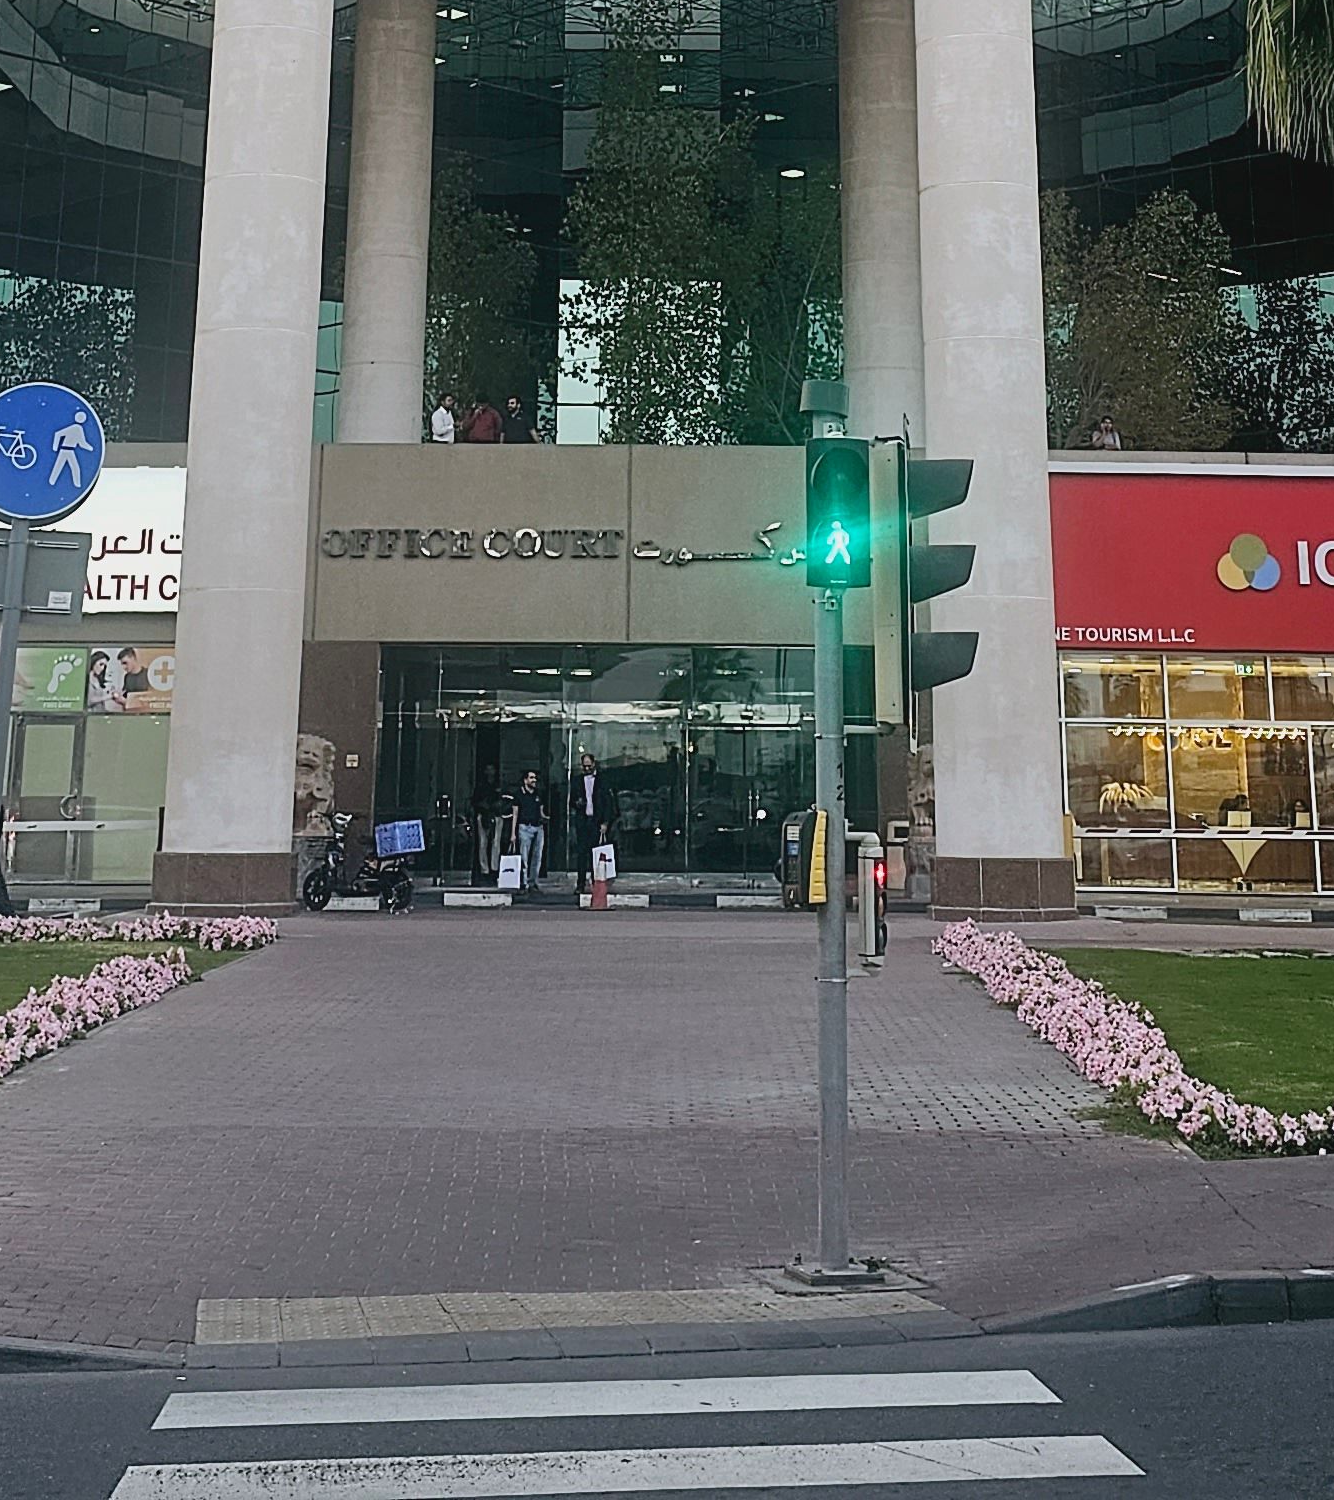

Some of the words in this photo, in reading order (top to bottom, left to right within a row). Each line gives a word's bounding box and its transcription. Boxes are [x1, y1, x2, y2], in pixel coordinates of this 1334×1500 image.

[90, 528, 154, 561] العر
[322, 527, 475, 558] OFFICE
[482, 527, 625, 558] COURT
[83, 574, 150, 600] ALTH
[1074, 627, 1154, 643] TOURISM
[1158, 628, 1196, 643] L.L.C
